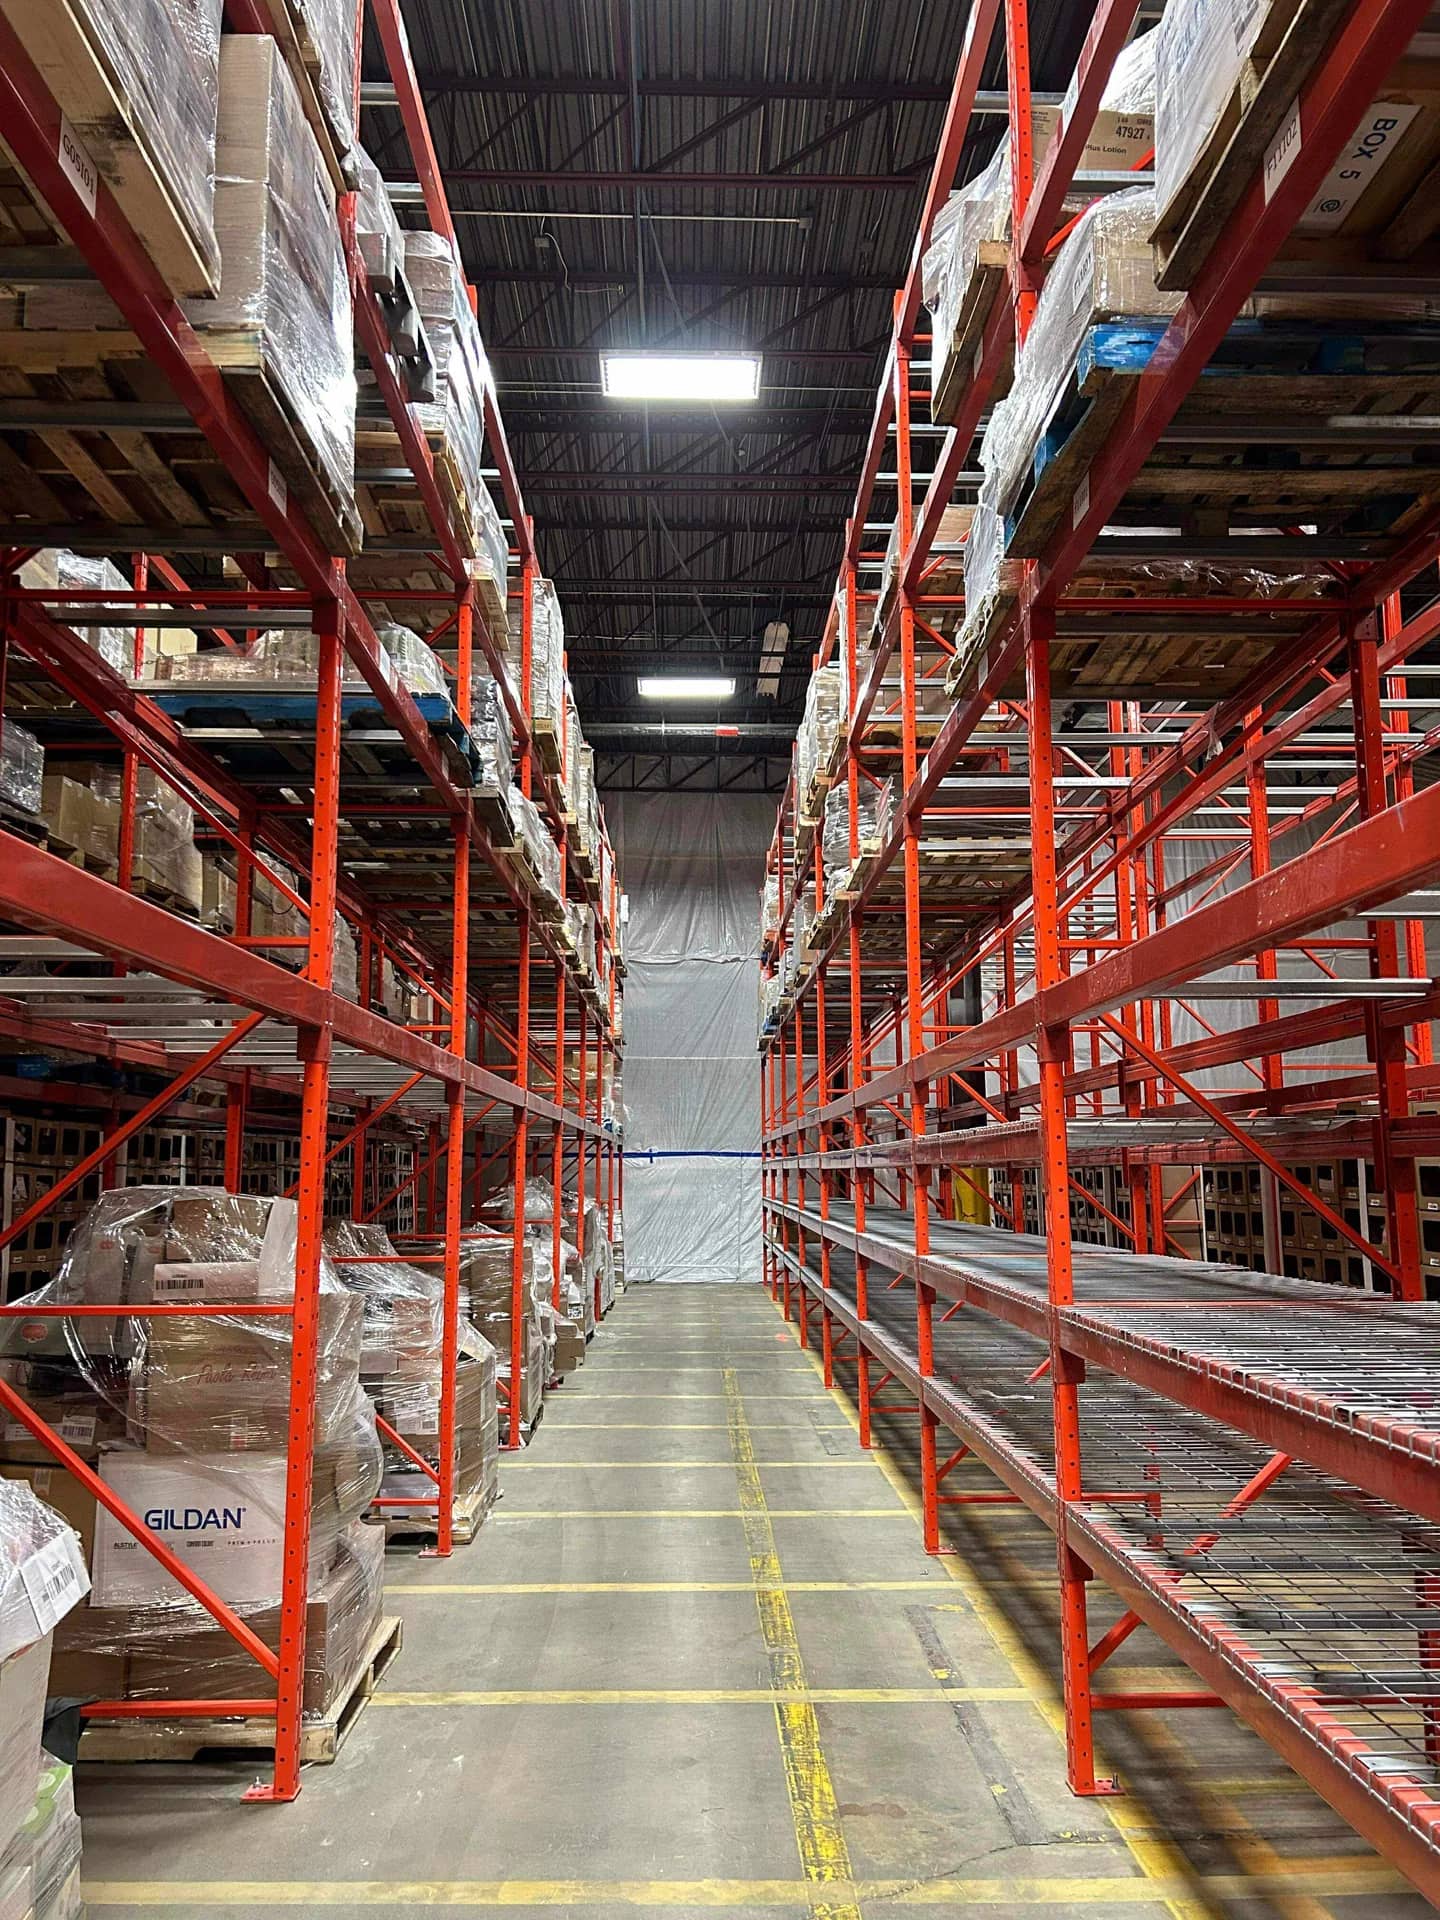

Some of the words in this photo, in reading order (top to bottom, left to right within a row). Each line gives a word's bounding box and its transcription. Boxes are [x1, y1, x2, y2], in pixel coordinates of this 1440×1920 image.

[1116, 126, 1145, 140] 47927
[1352, 118, 1399, 160] BOX
[1102, 146, 1127, 156] Lotion
[1339, 169, 1361, 180] 5
[144, 1507, 242, 1531] GILDAN
